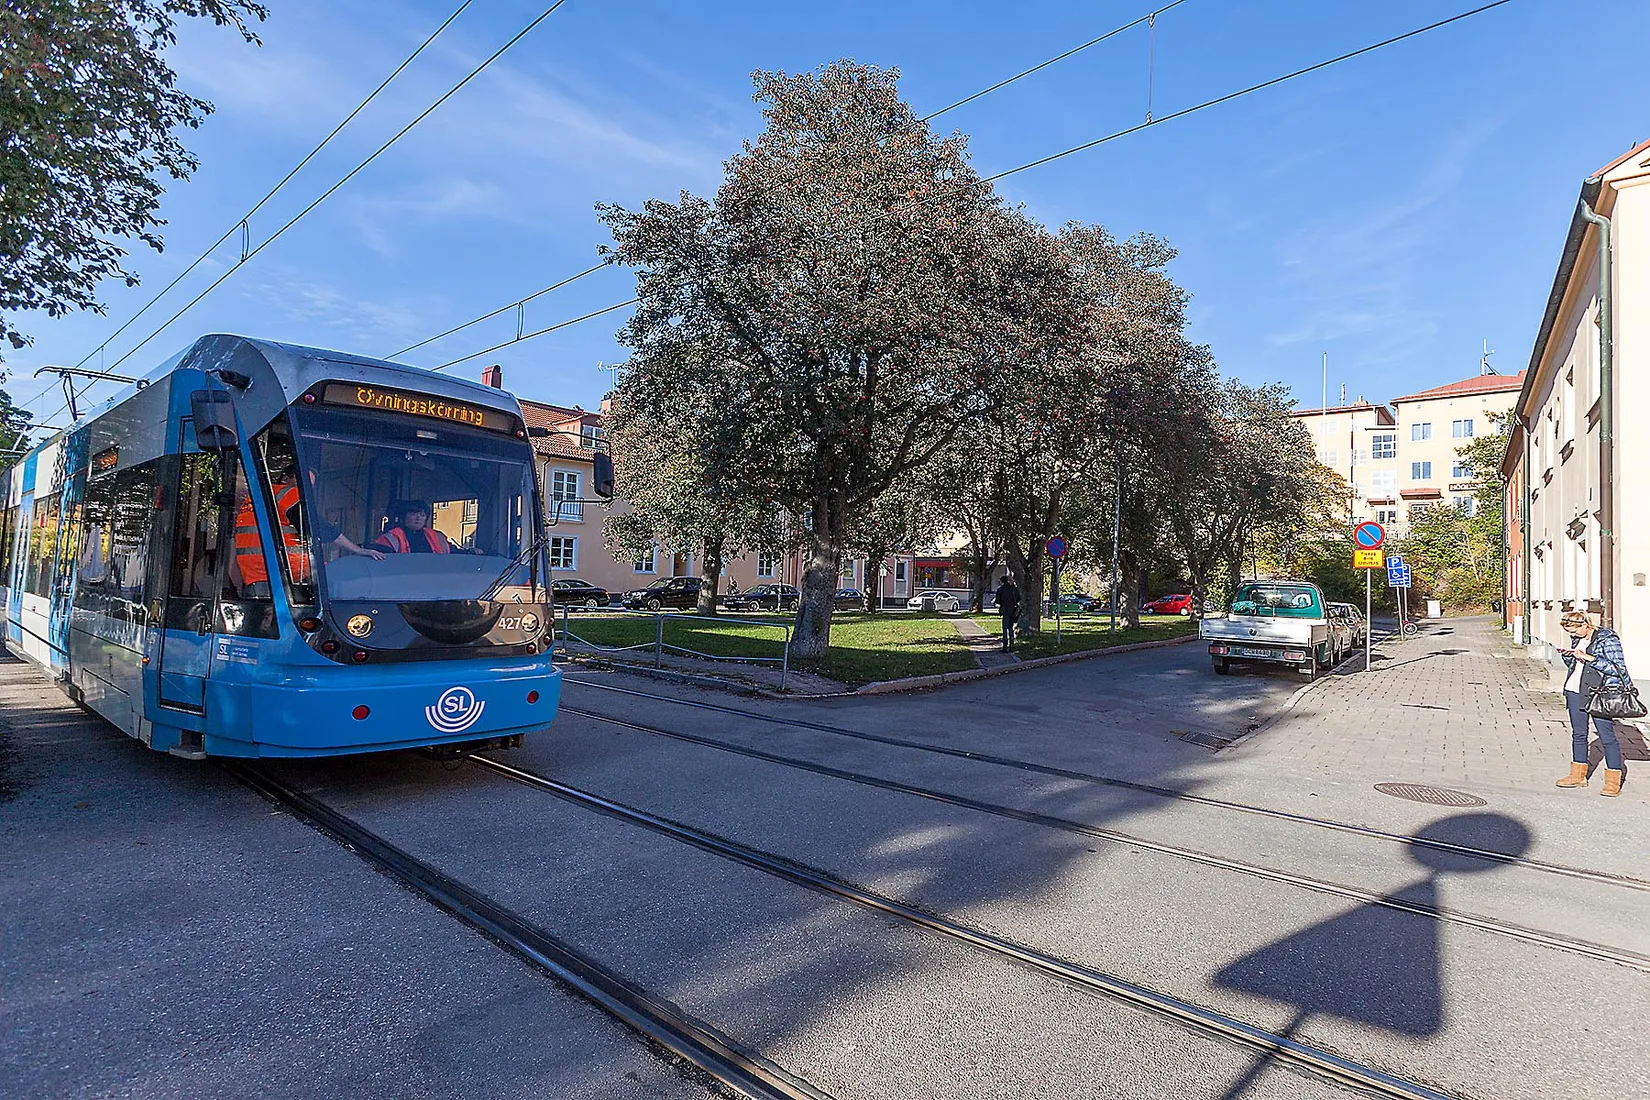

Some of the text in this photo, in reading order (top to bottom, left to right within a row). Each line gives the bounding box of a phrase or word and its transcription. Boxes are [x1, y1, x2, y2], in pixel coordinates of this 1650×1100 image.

[356, 386, 484, 426] Övningskörning
[1391, 558, 1400, 567] P
[498, 617, 521, 630] 427
[444, 695, 469, 713] SL
